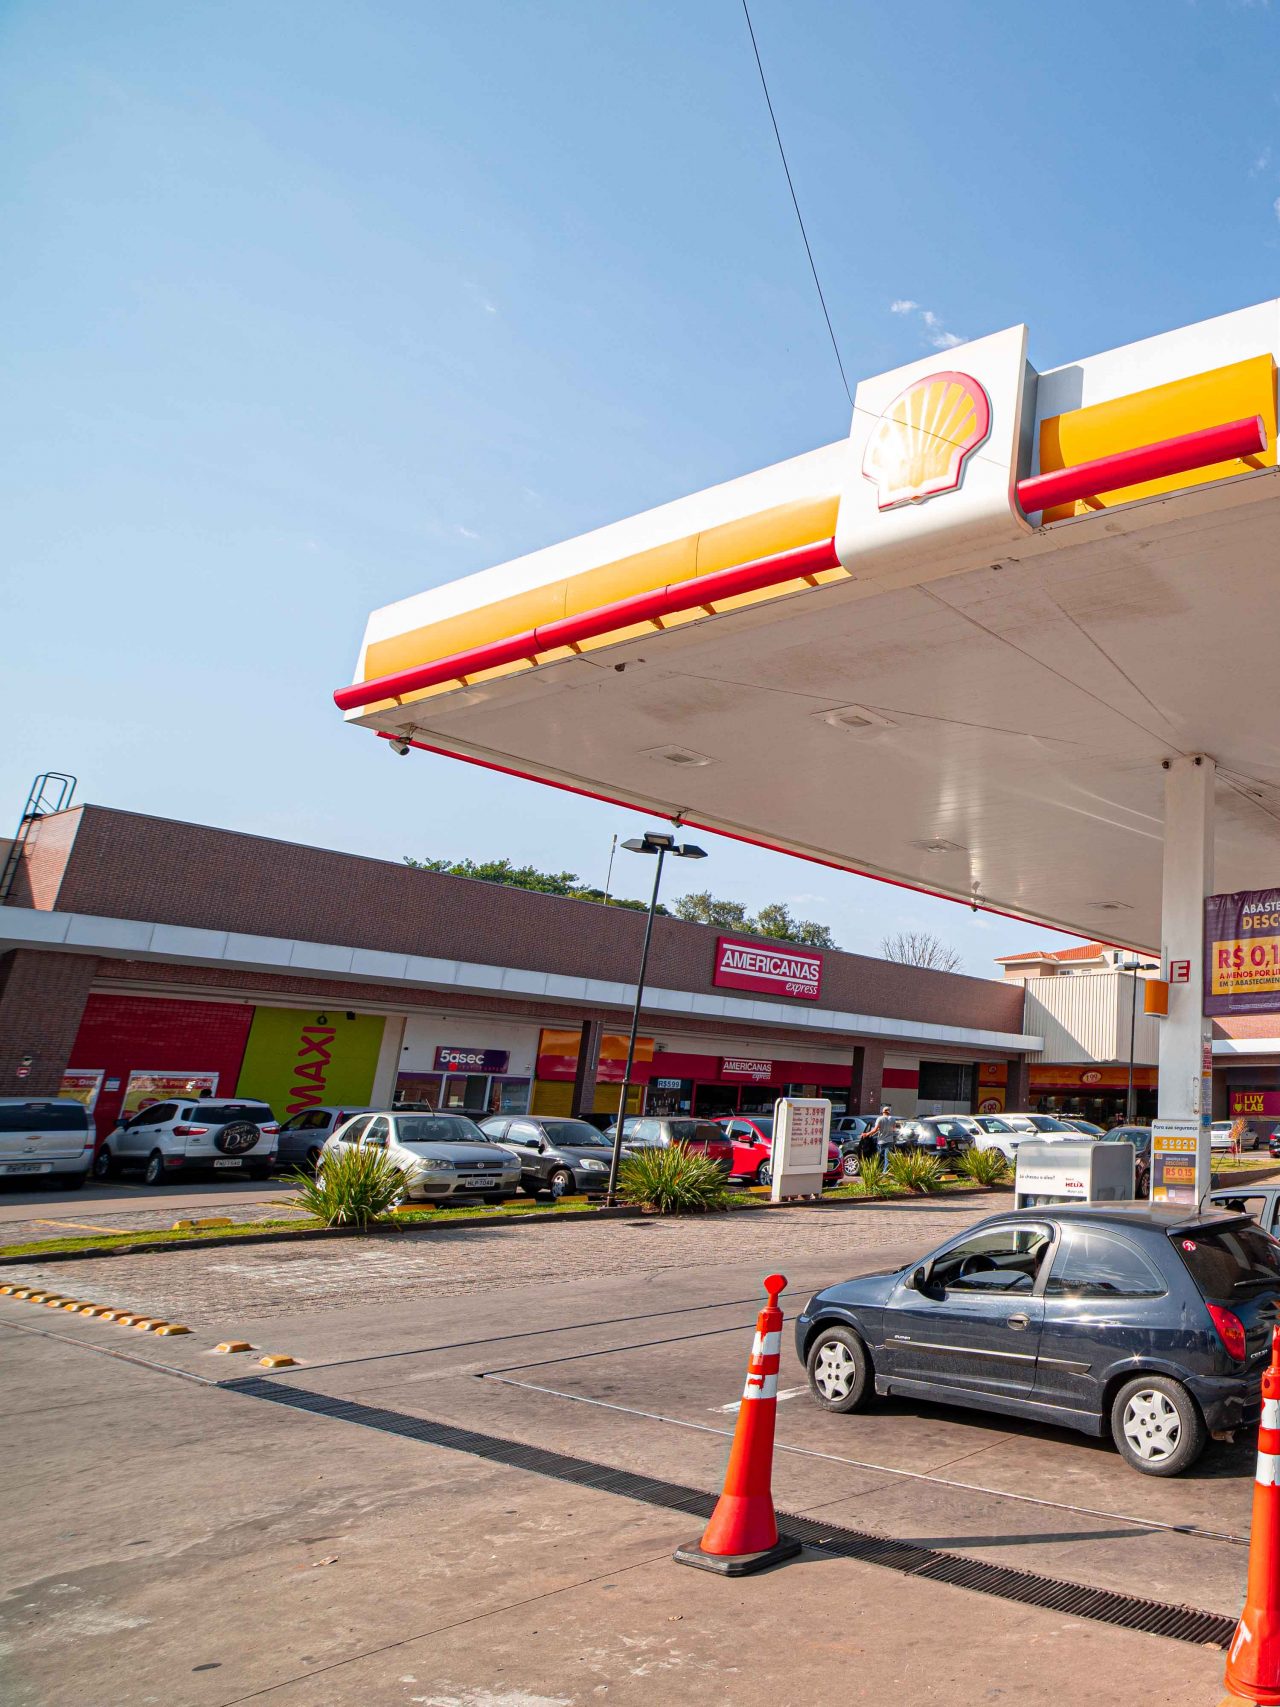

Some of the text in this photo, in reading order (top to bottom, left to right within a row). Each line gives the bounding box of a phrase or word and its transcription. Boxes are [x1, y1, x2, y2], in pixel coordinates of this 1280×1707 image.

[1218, 944, 1245, 970] R$
[722, 950, 820, 980] AMERICANAS
[1172, 962, 1189, 982] E
[1227, 970, 1253, 979] MENOS
[1255, 969, 1271, 977] POR
[785, 982, 818, 995] express
[440, 1049, 485, 1065] 5asec
[286, 1026, 337, 1114] MAXI
[723, 1060, 772, 1072] AMERICANAS
[751, 1073, 771, 1082] express
[1244, 1095, 1264, 1104] LUV
[1244, 1103, 1264, 1112] LAB
[1165, 1167, 1193, 1177] R$ 0,15
